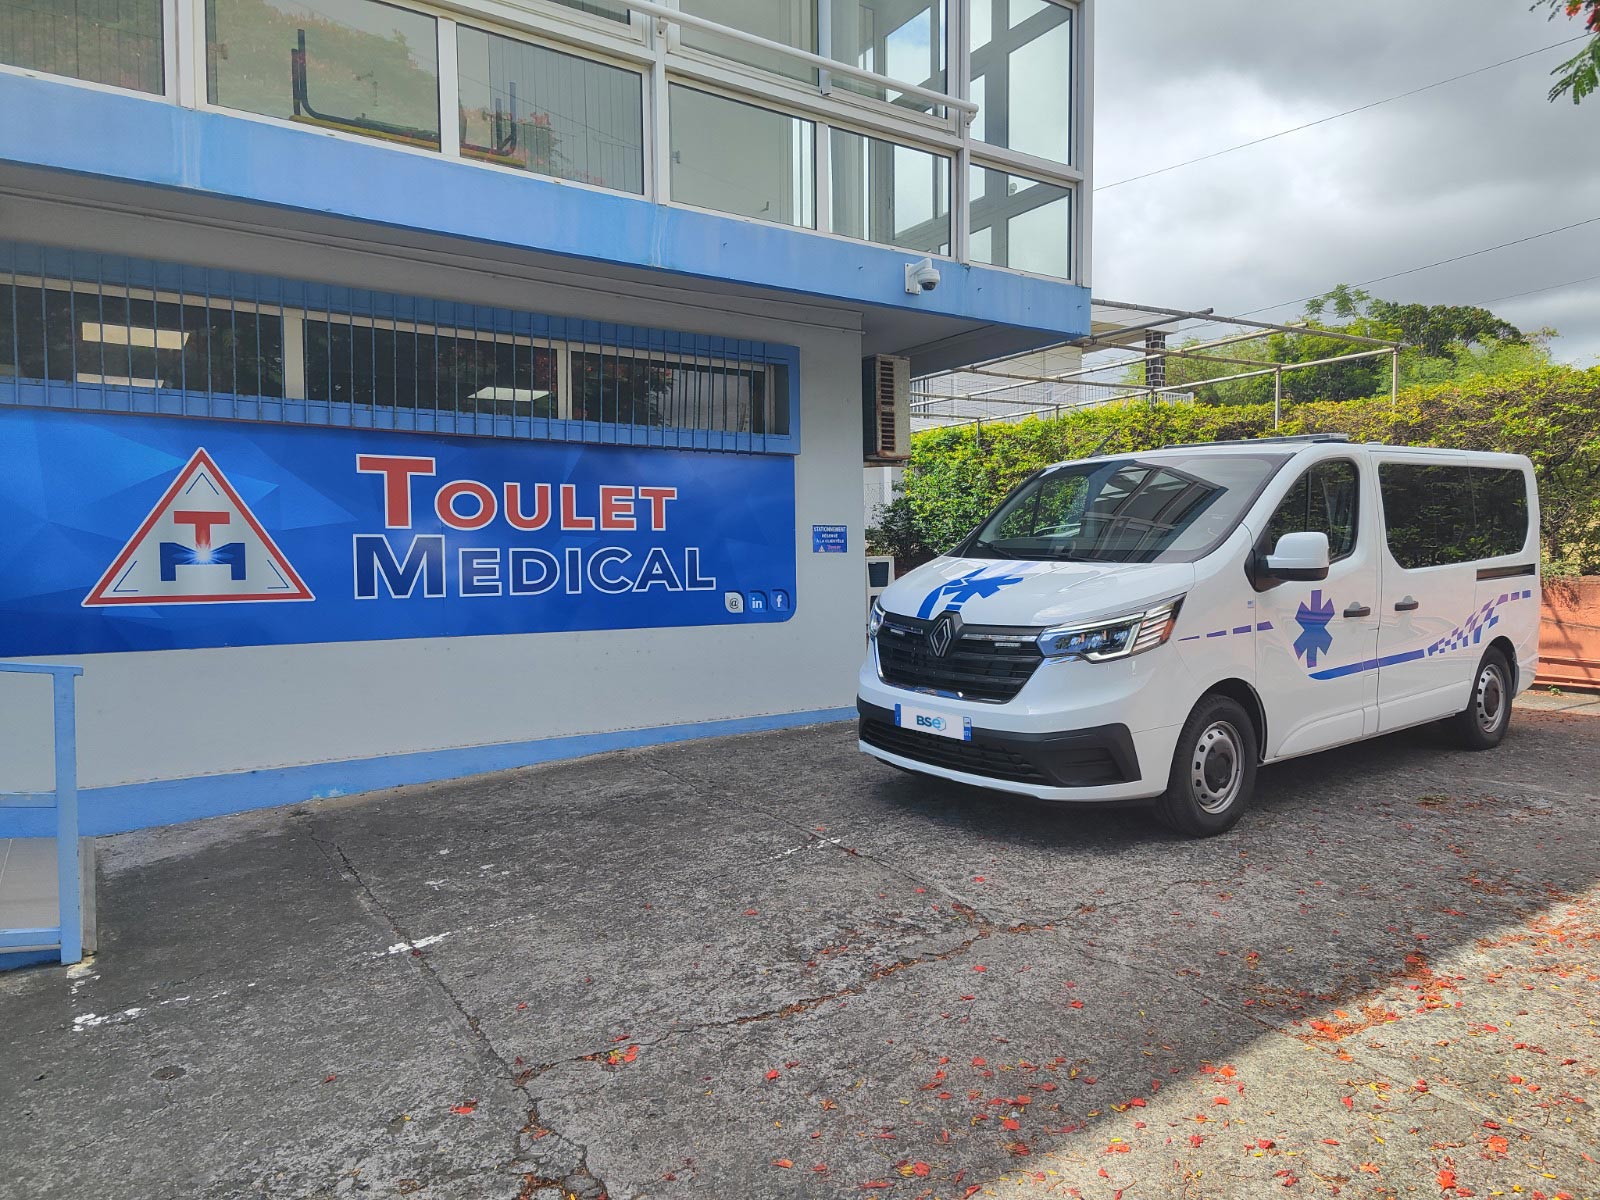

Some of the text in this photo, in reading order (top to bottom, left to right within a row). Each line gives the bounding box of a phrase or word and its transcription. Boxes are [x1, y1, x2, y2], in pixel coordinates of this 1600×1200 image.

[356, 454, 677, 531] TOULET
[352, 534, 716, 600] MEDICAL
[752, 597, 763, 608] in
